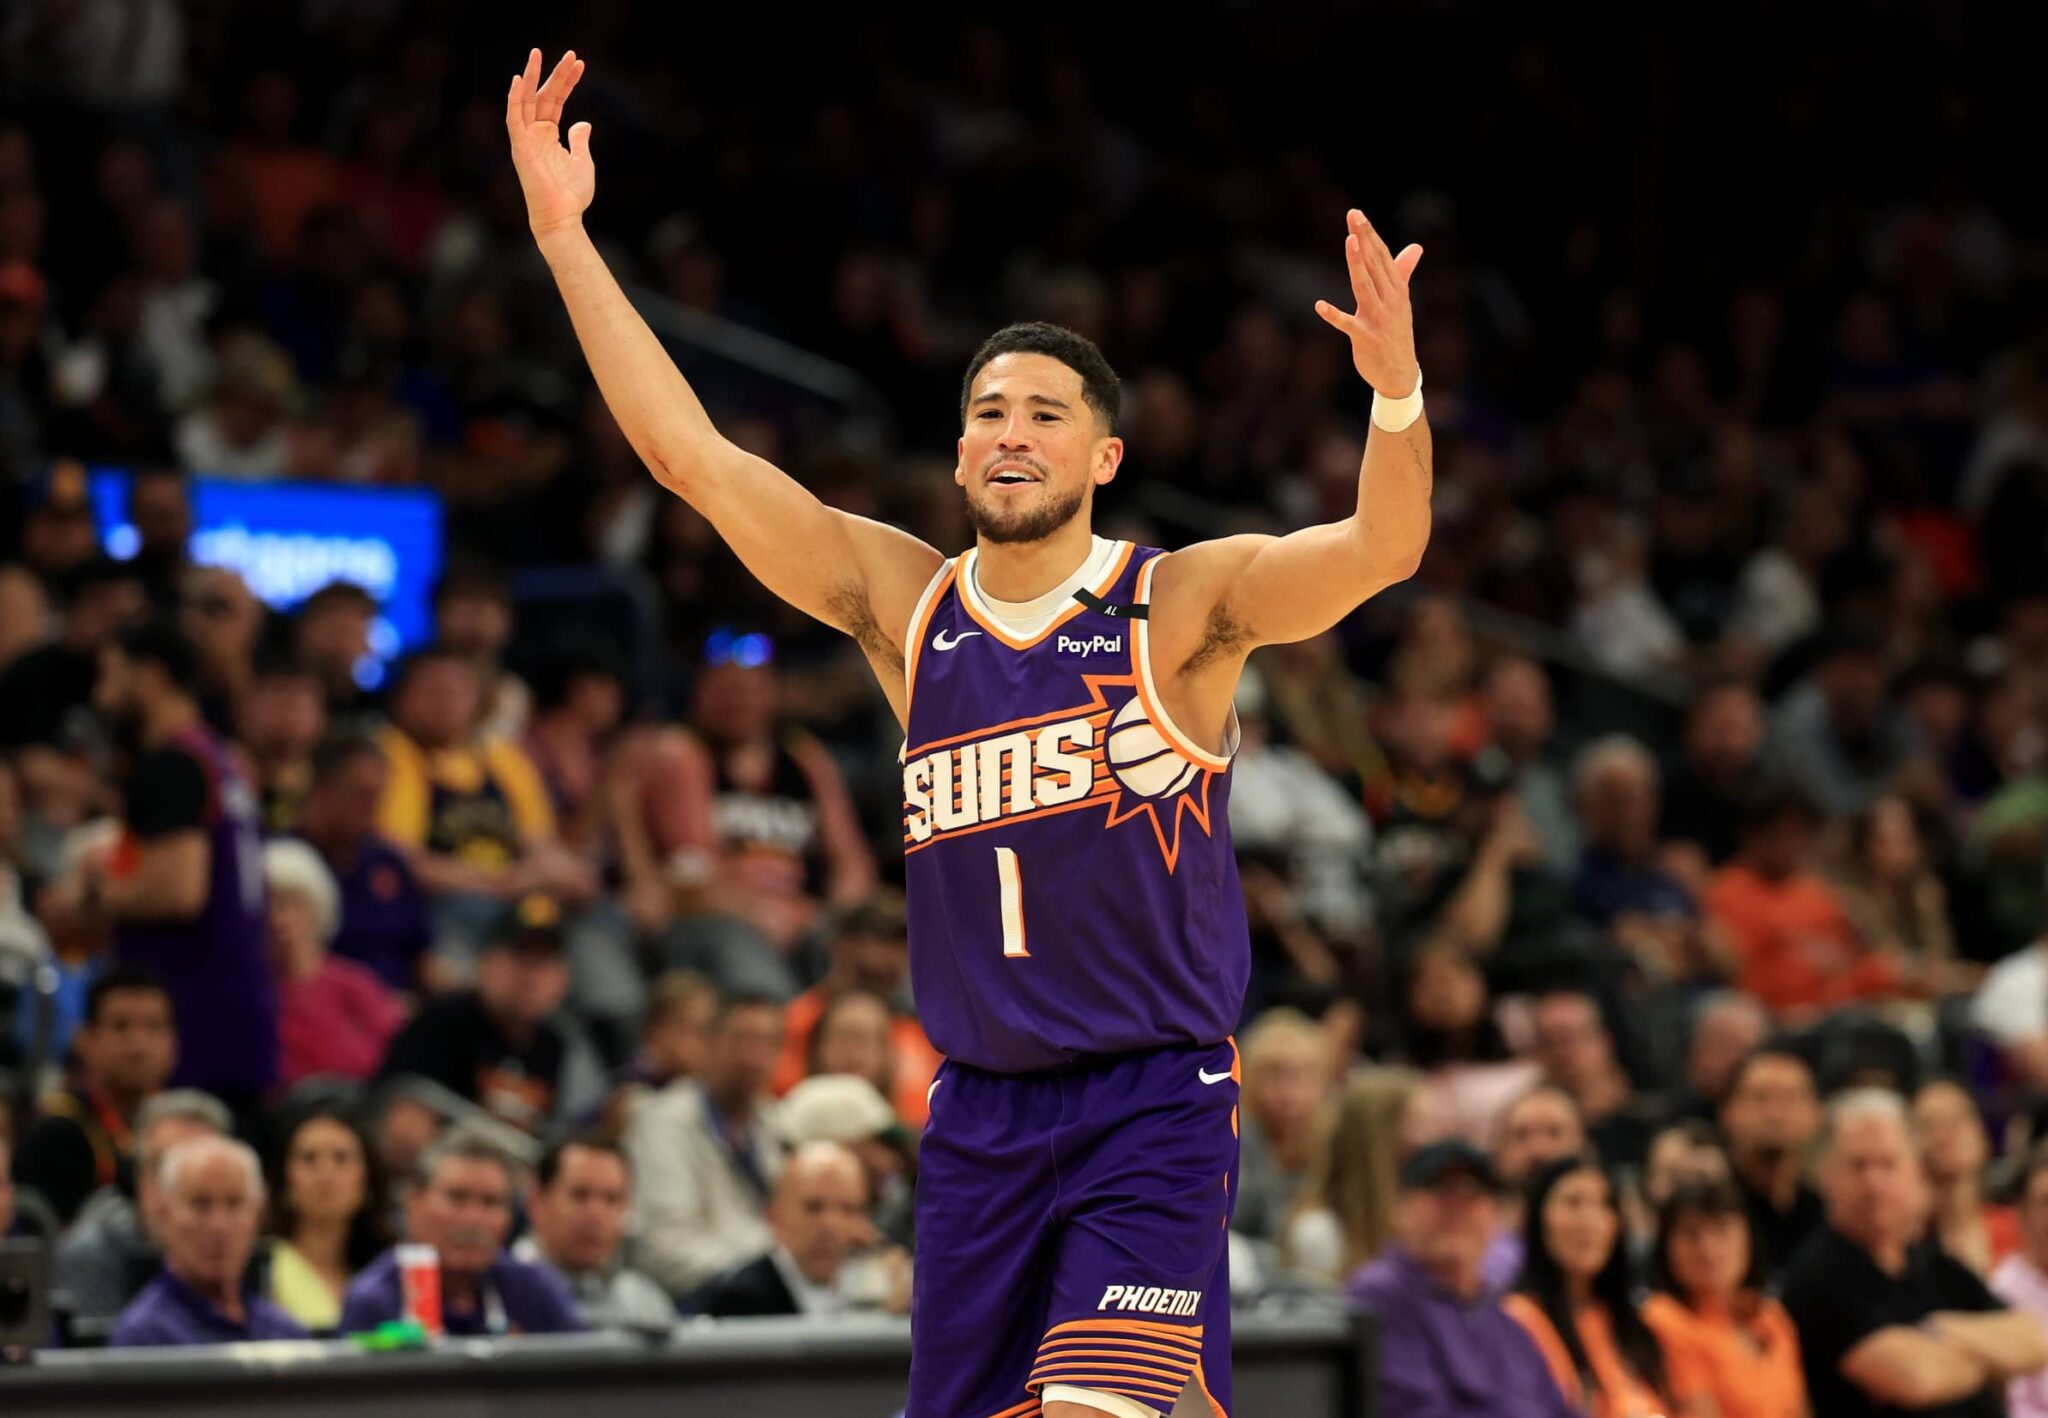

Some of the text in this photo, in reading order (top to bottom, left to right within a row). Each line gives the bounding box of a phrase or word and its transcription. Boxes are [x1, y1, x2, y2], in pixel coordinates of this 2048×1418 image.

[1103, 605, 1118, 617] AL
[1057, 635, 1121, 658] PayPal
[903, 718, 1094, 843] SUNS
[994, 847, 1031, 958] 1
[1097, 1285, 1201, 1316] PHOENIX
